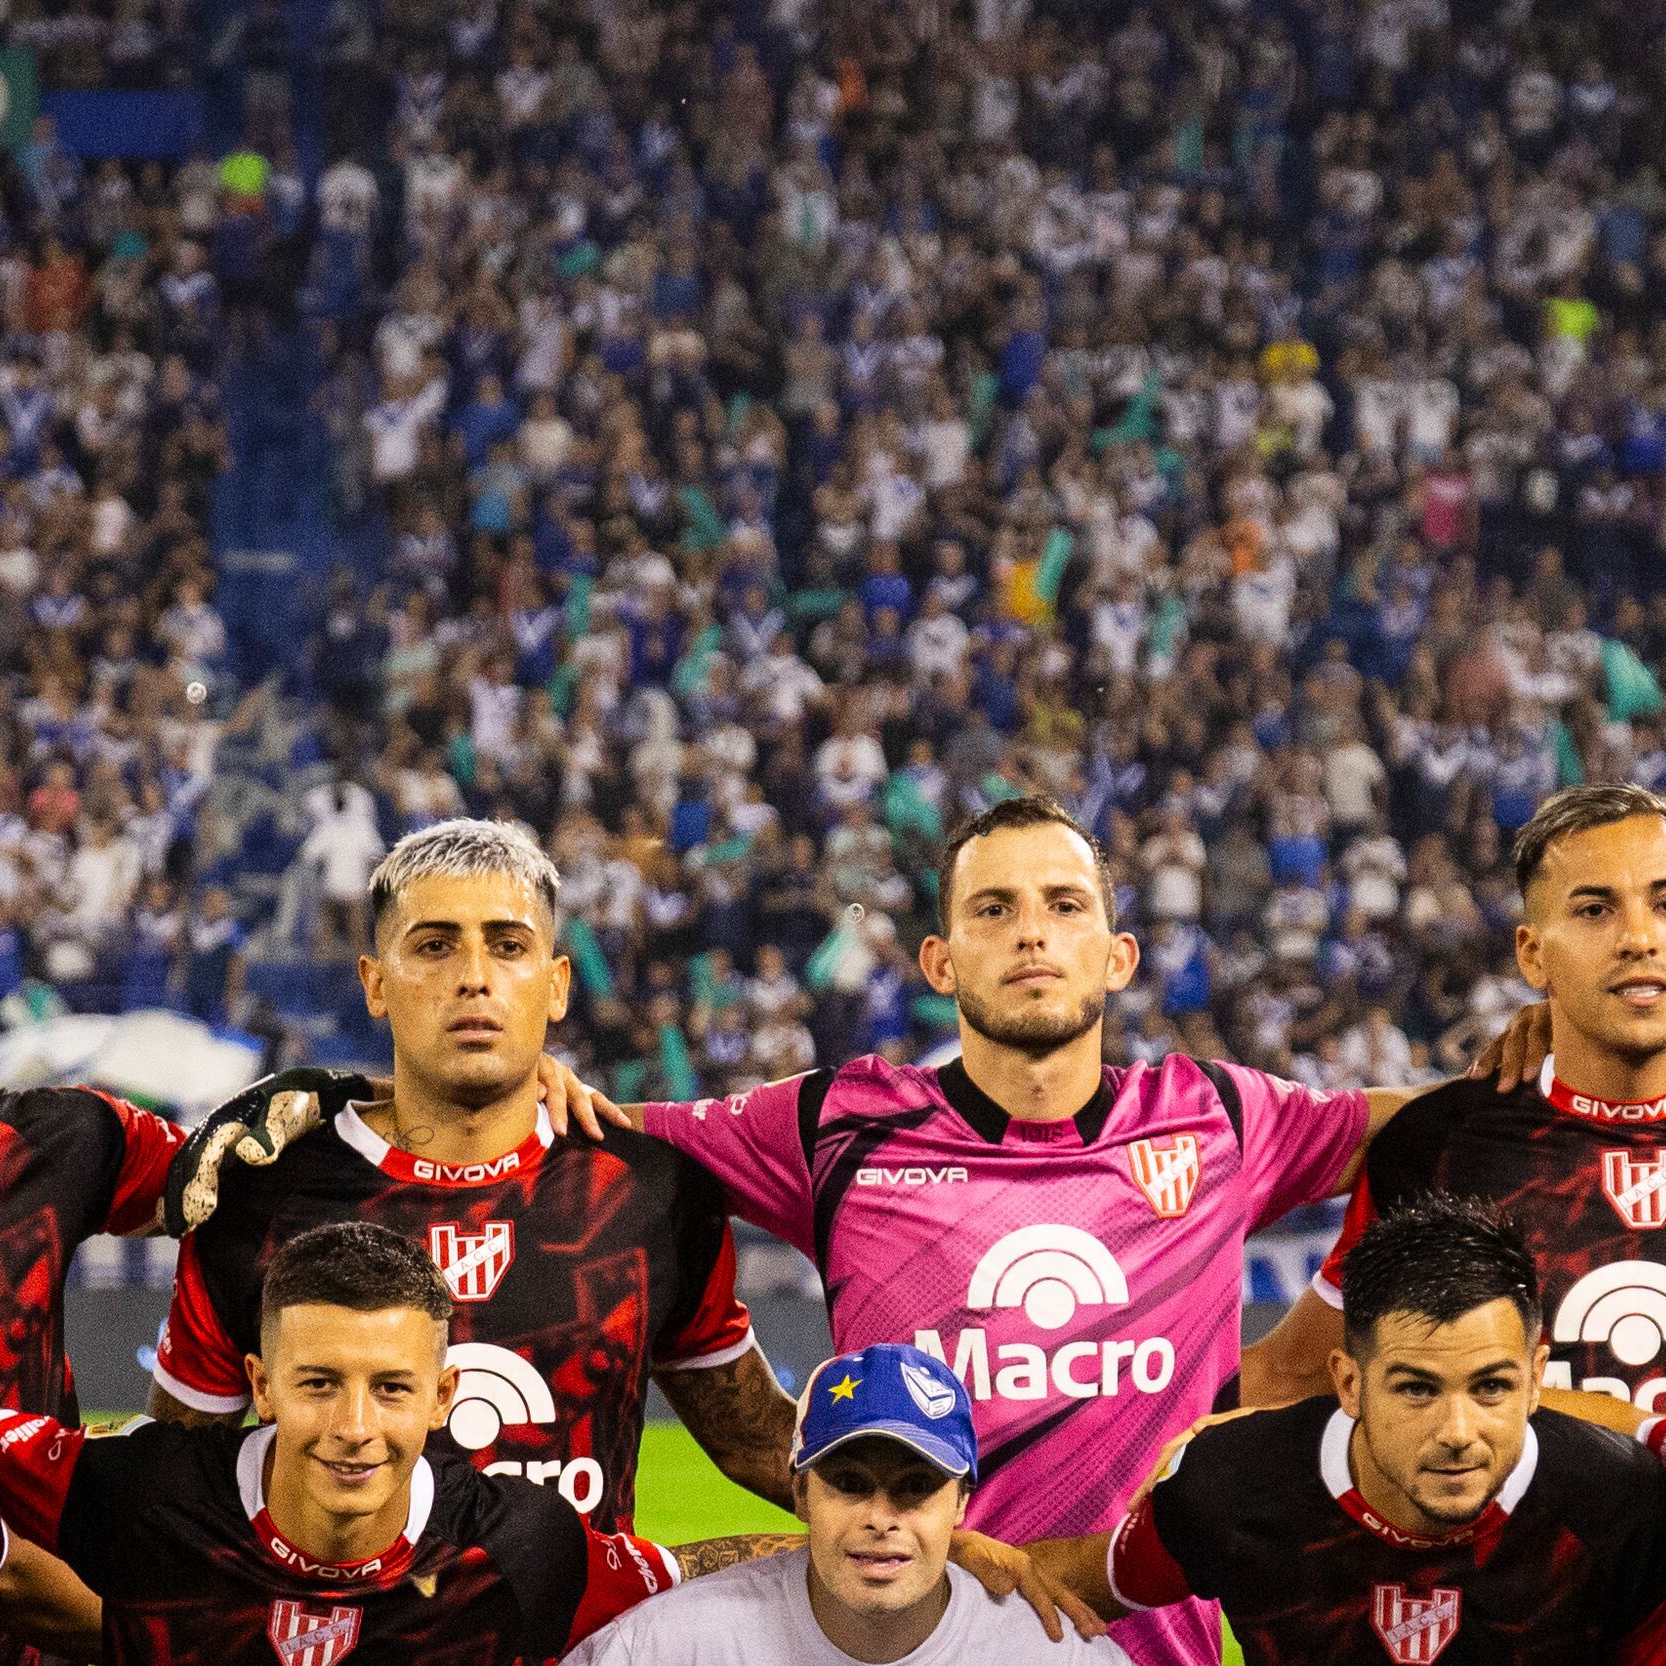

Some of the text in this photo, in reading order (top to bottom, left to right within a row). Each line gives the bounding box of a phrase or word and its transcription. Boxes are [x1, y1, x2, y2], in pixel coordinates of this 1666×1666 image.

[412, 1151, 520, 1182] GIVOVA
[857, 1166, 969, 1186] GIVOVA
[914, 1328, 1176, 1401] Macro
[1362, 1512, 1474, 1548] GIVOVA
[270, 1536, 382, 1579] GIVOVA
